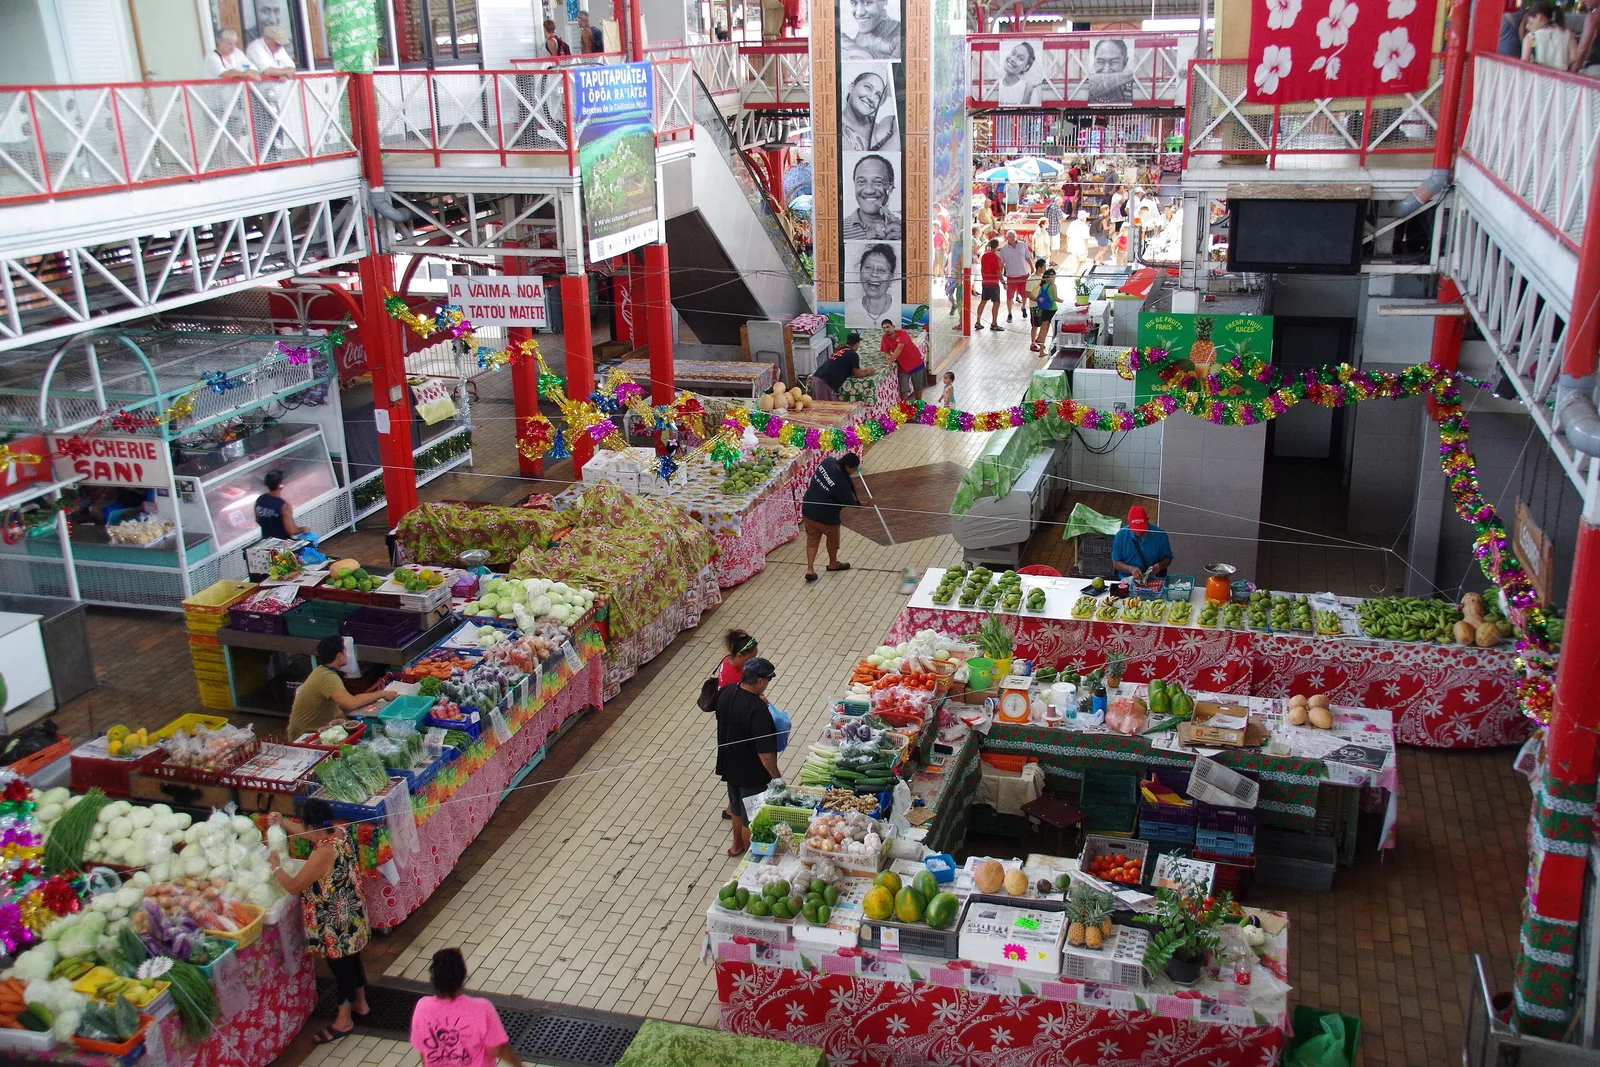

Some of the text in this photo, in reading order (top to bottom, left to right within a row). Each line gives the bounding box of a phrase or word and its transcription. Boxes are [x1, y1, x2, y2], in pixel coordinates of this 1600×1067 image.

[450, 284, 542, 298] IA VAIMA NOA
[469, 305, 506, 319] TATOU
[510, 305, 545, 320] MATETE
[1155, 323, 1172, 331] FRAIS
[1164, 316, 1184, 331] FRUITS
[1225, 318, 1264, 331] FRESH FRUIT
